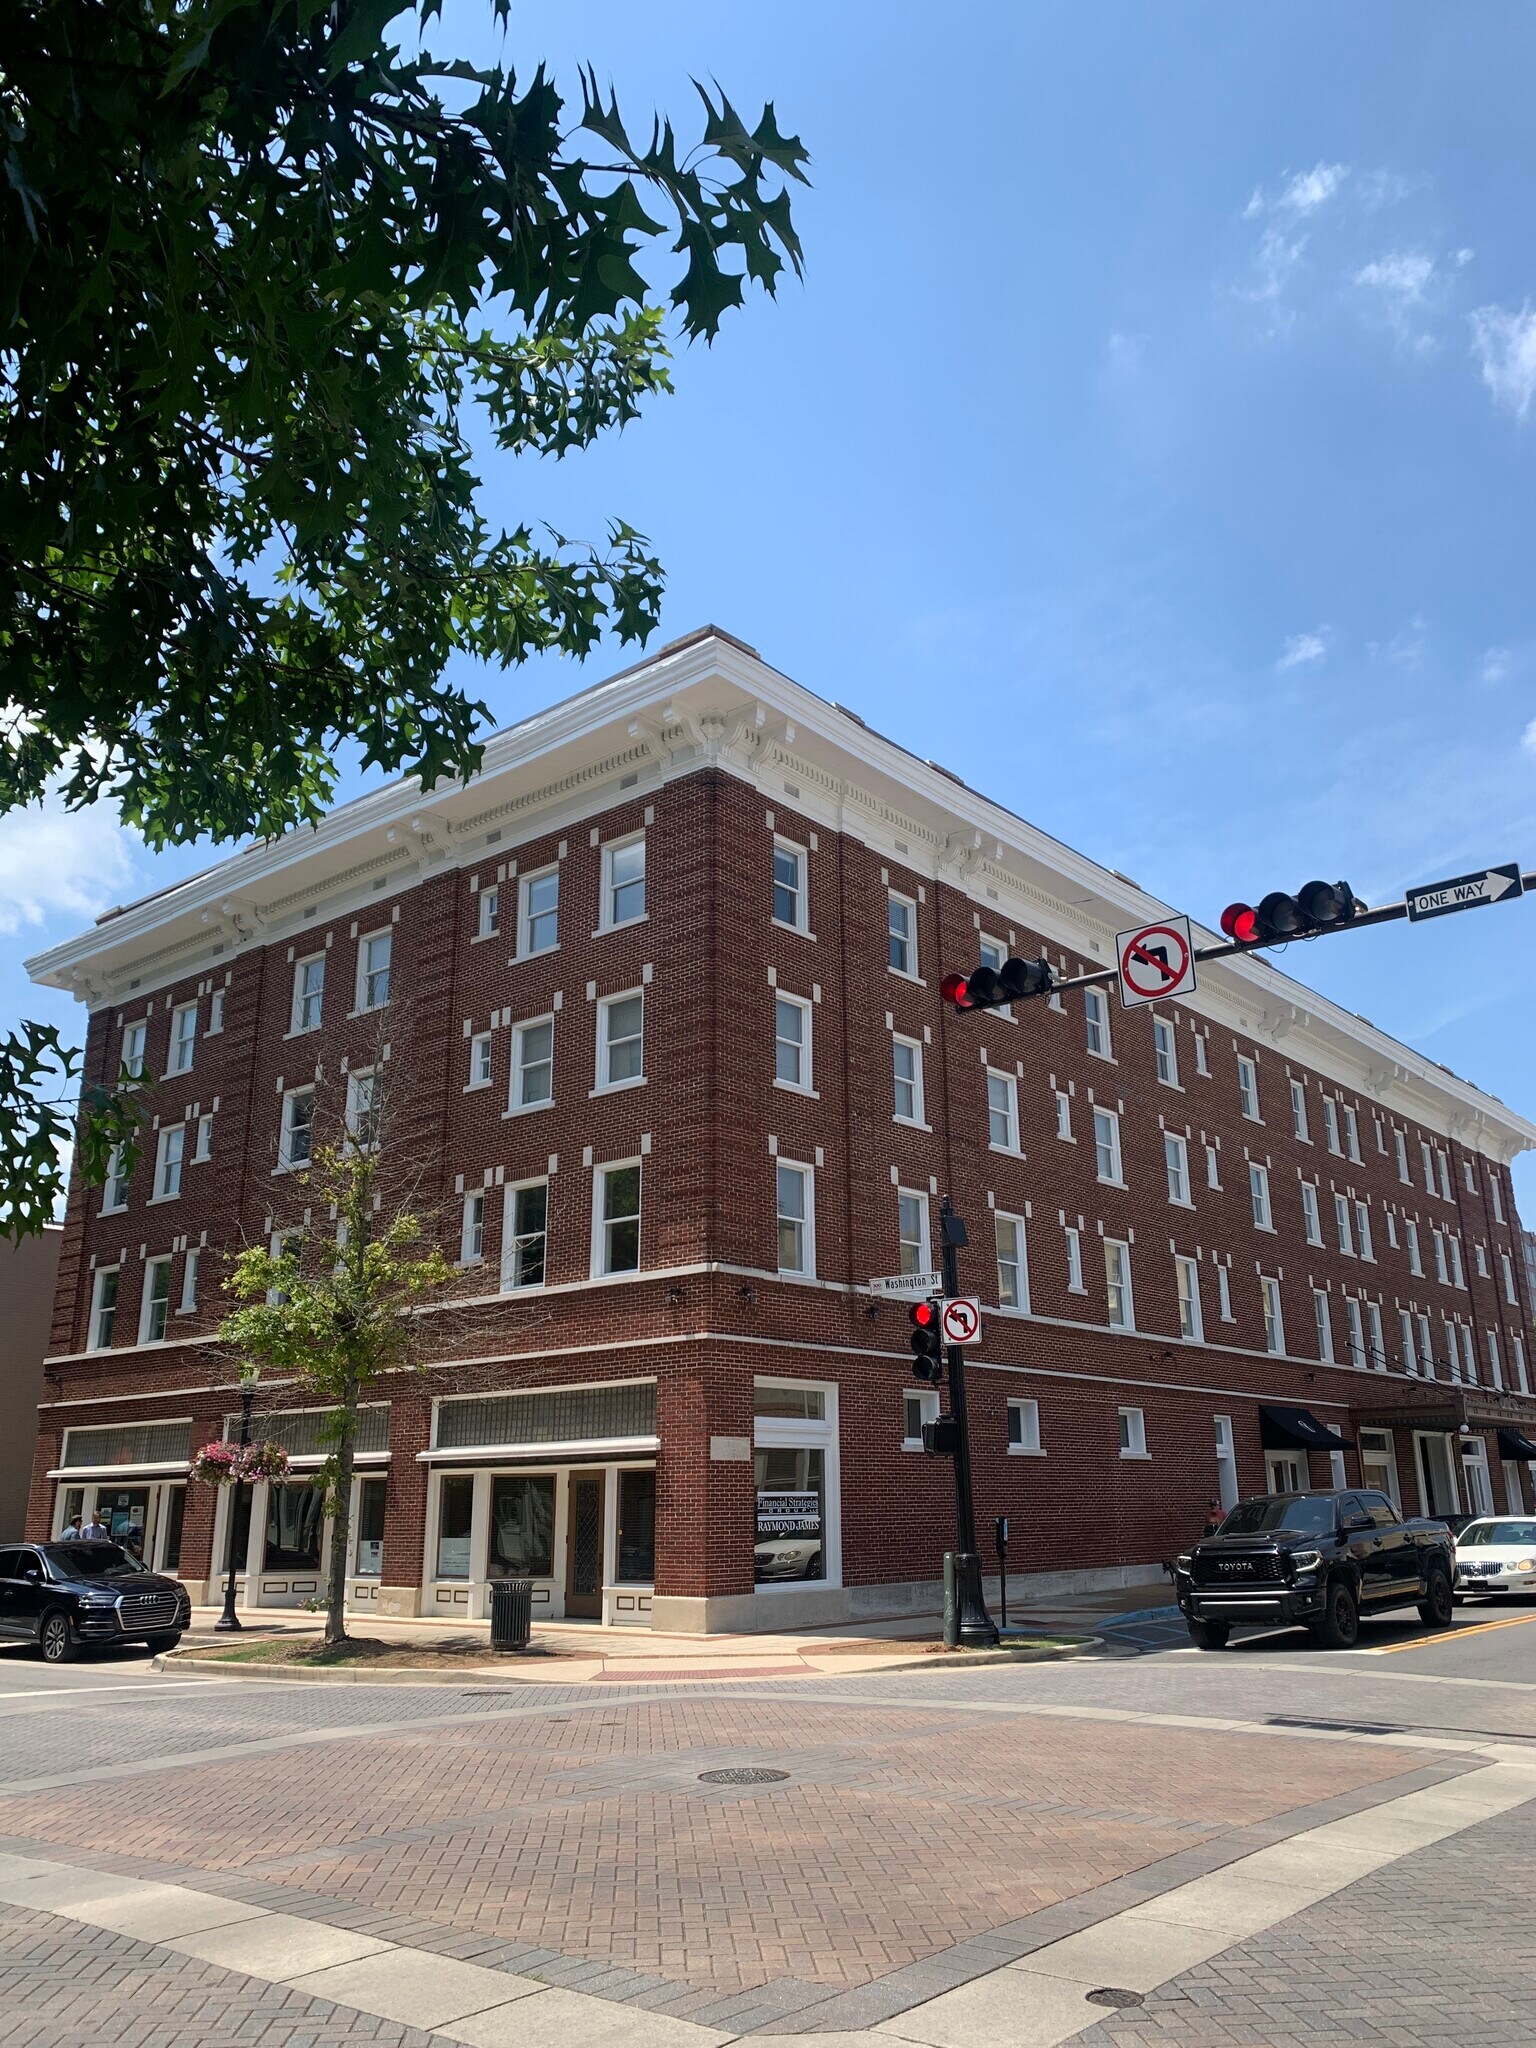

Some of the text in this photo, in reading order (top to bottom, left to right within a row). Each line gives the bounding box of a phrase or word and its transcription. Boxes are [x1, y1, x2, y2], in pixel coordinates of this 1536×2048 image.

[1419, 882, 1484, 910] ONE WAY
[885, 1274, 938, 1289] Washington St
[757, 1497, 819, 1509] Financial Strategies
[757, 1520, 820, 1531] RAYMOND JAMES
